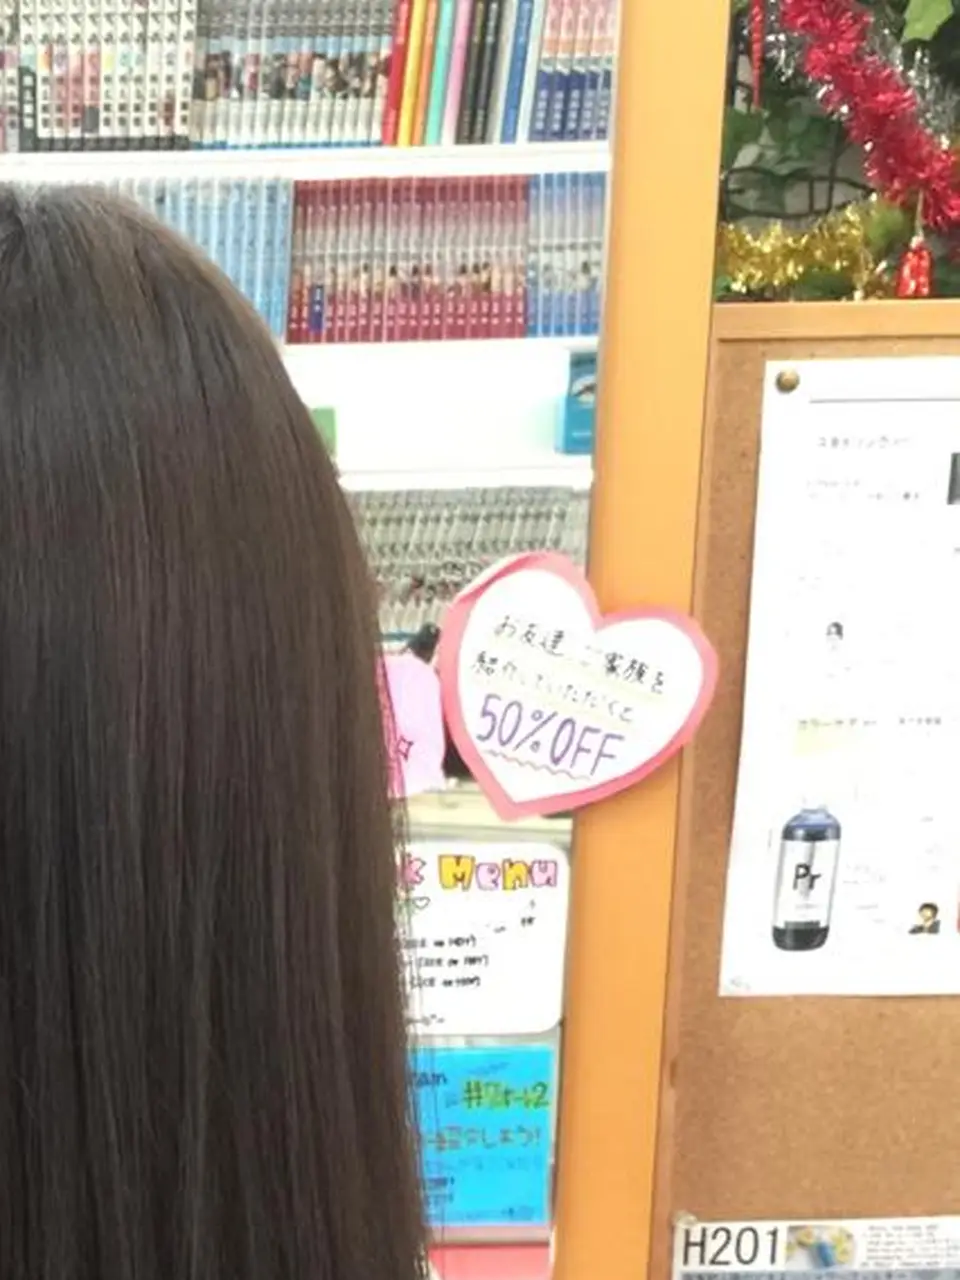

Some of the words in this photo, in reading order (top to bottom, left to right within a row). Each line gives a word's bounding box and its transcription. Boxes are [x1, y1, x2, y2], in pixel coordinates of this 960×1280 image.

[476, 693, 626, 776] 50%OFF
[438, 854, 558, 892] Menu
[682, 1226, 779, 1267] H201
